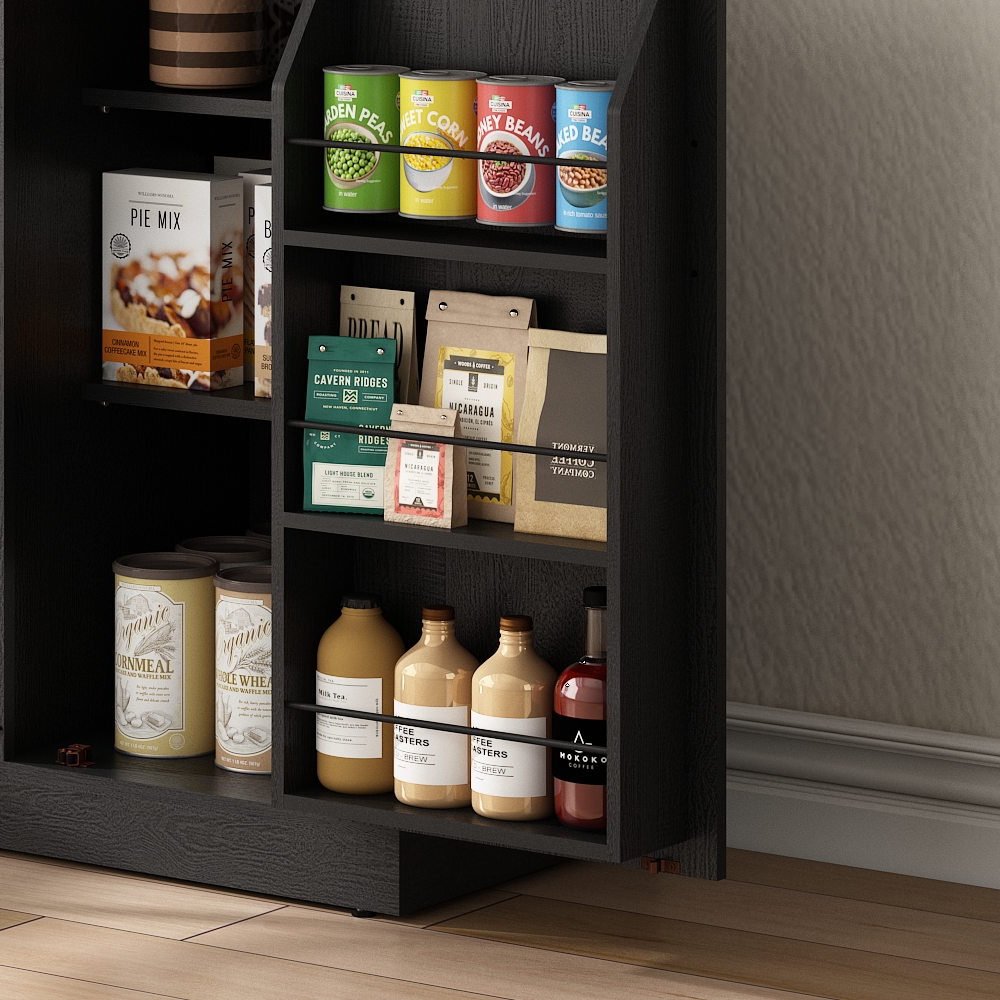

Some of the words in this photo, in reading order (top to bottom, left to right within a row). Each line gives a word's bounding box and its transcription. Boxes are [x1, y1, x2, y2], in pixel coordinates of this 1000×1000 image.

[412, 95, 432, 103] CUISINA
[569, 110, 590, 118] CUISINA
[324, 103, 357, 130] ARDEN
[359, 107, 393, 144] PEAS
[400, 109, 423, 134] WEET
[426, 110, 469, 148] CORN
[477, 114, 502, 138] DNEY
[505, 115, 550, 157] BEANS
[557, 124, 579, 150] AKED
[581, 125, 607, 150] BEA
[131, 208, 151, 228] PIE
[158, 210, 181, 231] MIX
[222, 241, 233, 269] MIX
[222, 277, 233, 303] PIE
[111, 338, 140, 348] CINNAMON
[104, 346, 137, 357] COFFEECAKE
[137, 349, 147, 357] MIX
[314, 374, 351, 387] CAVERN
[354, 376, 388, 389] RIDGES
[313, 441, 337, 449] COMPANY
[358, 434, 389, 445] RIDGES
[239, 674, 272, 688] WHEA
[318, 688, 331, 698] Milk
[332, 692, 347, 701] Tea.
[394, 725, 415, 736] FFEE
[394, 734, 430, 747] ASTERS
[473, 735, 493, 748] FFEE
[404, 753, 428, 763] BREW
[473, 745, 508, 759] ASTERS
[481, 765, 506, 775] BREW
